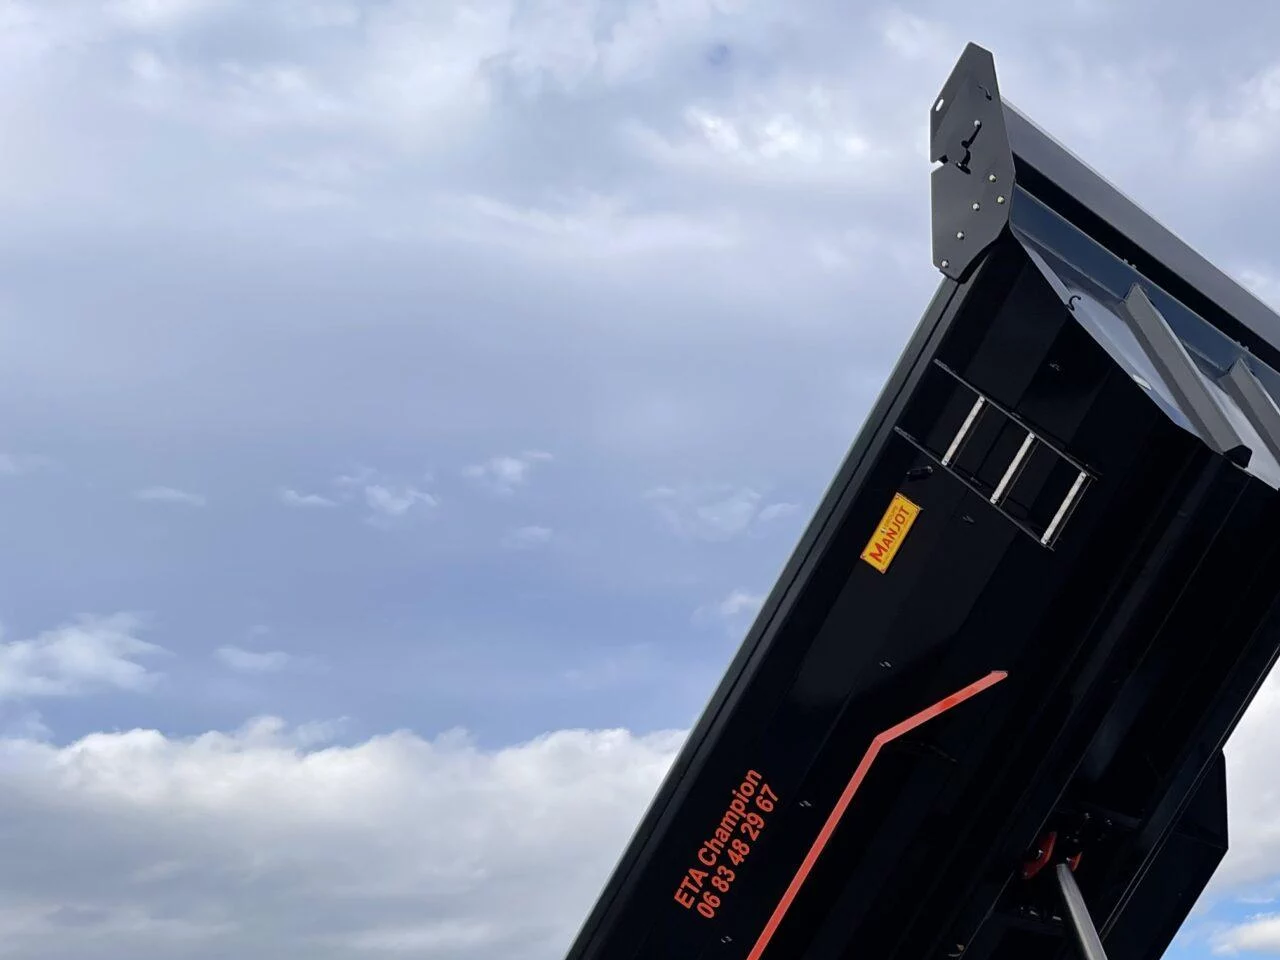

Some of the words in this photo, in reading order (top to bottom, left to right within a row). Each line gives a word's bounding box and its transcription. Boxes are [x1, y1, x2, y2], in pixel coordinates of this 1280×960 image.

[869, 505, 910, 563] MANJOT
[674, 868, 709, 909] ETA
[698, 769, 762, 866] Champion
[697, 891, 721, 919] 06
[711, 865, 736, 892] 83
[727, 839, 750, 866] 48
[740, 812, 765, 841] 29
[756, 783, 779, 812] 67
